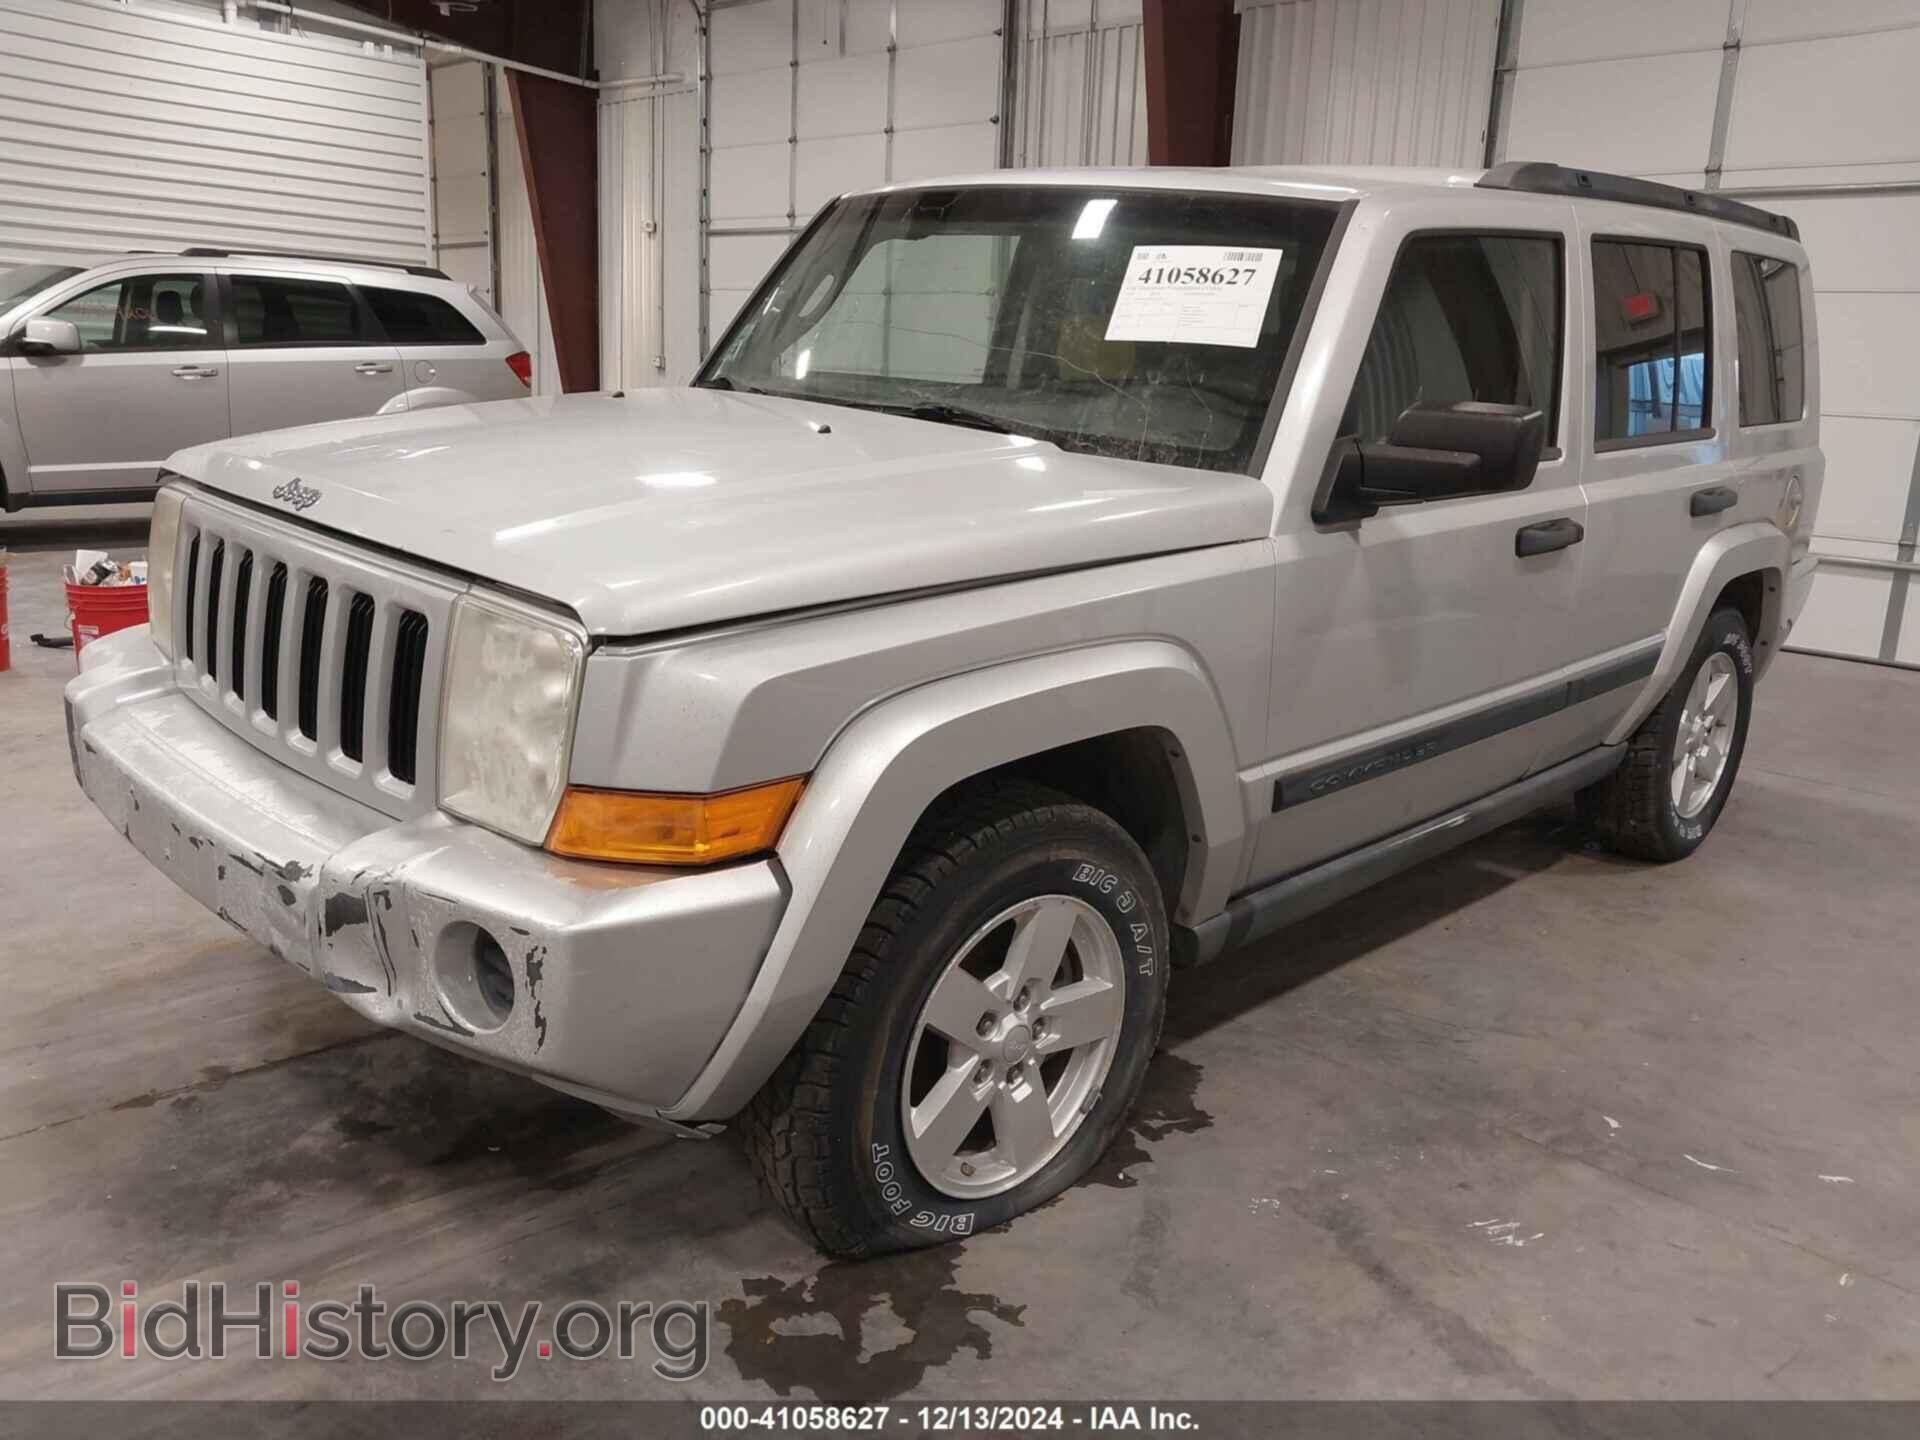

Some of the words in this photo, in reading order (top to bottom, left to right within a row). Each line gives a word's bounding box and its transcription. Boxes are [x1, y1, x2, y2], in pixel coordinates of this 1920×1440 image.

[1138, 267, 1257, 286] 41058627
[1072, 863, 1119, 894] BIG
[1129, 922, 1154, 977] A/T
[871, 1142, 913, 1217] FOOT
[909, 1212, 975, 1236] BIG
